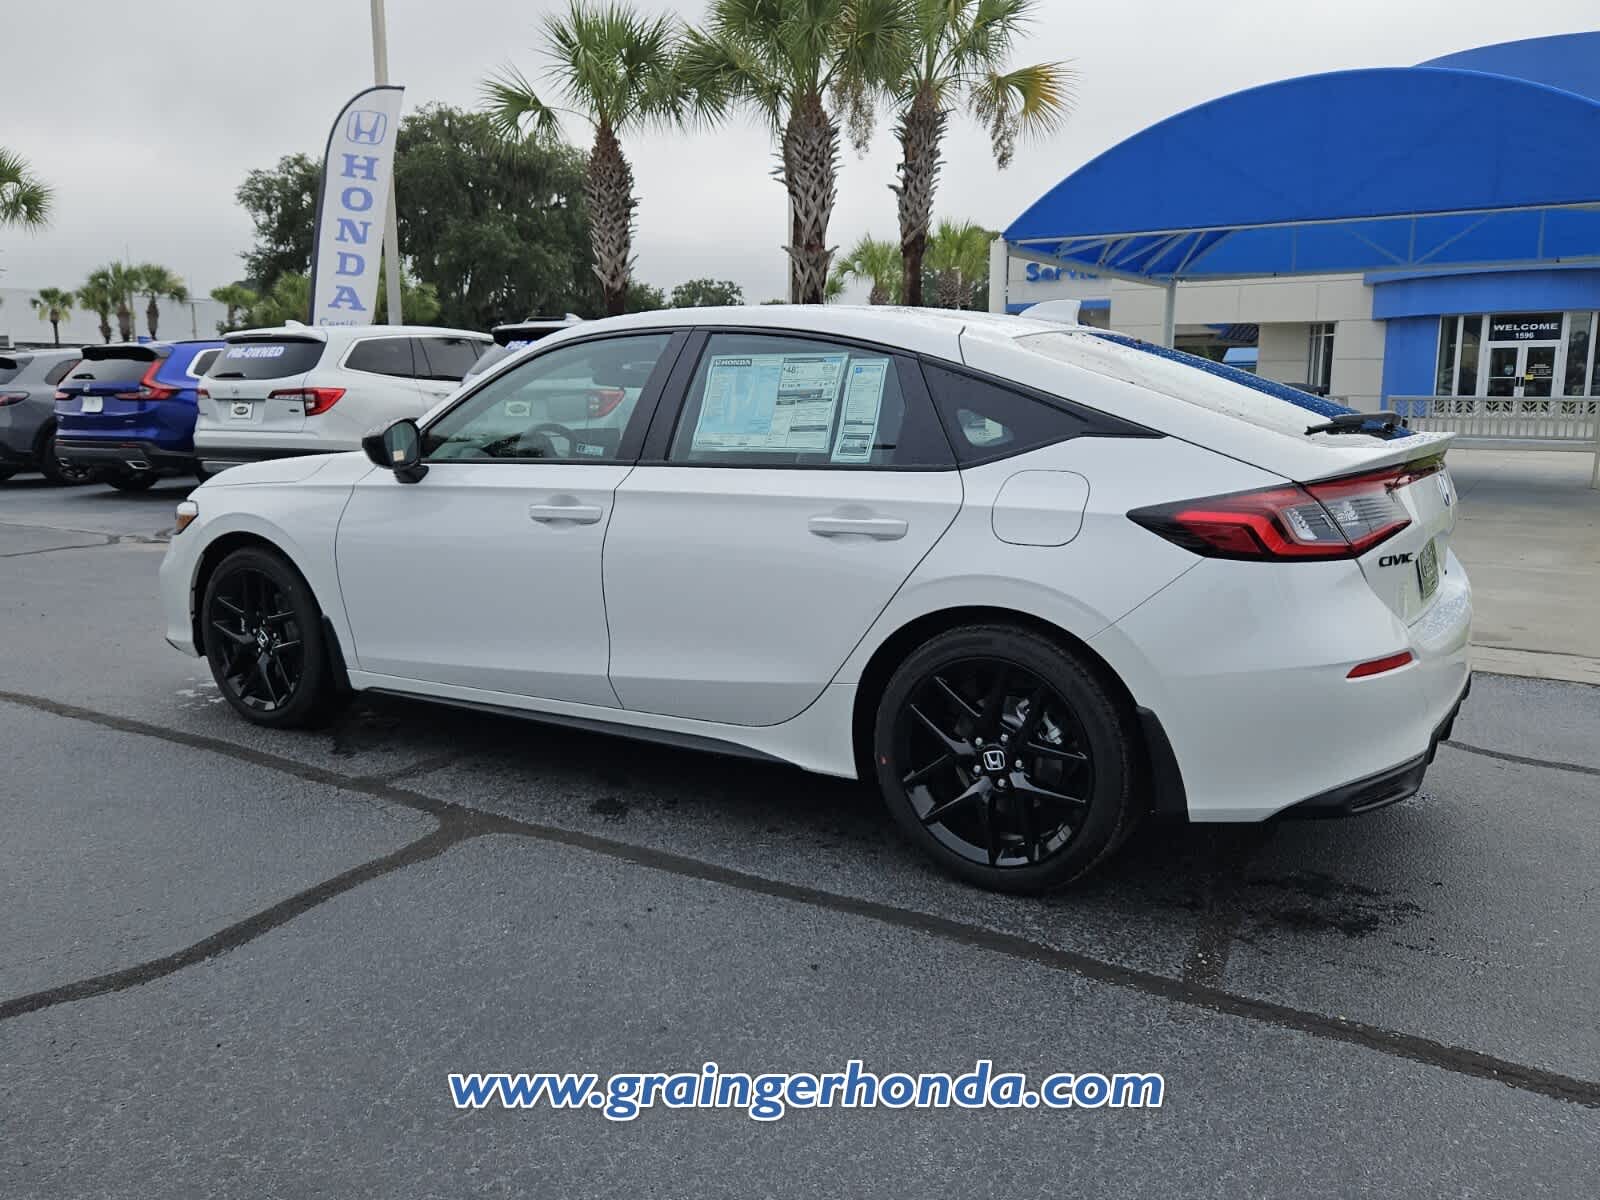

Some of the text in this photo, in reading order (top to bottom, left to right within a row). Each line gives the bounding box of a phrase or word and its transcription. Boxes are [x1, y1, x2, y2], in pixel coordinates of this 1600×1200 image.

[328, 153, 379, 311] HONDA
[1493, 322, 1559, 331] WELCOME
[226, 346, 285, 359] PRE-OWNED
[1378, 552, 1414, 567] CIVIC
